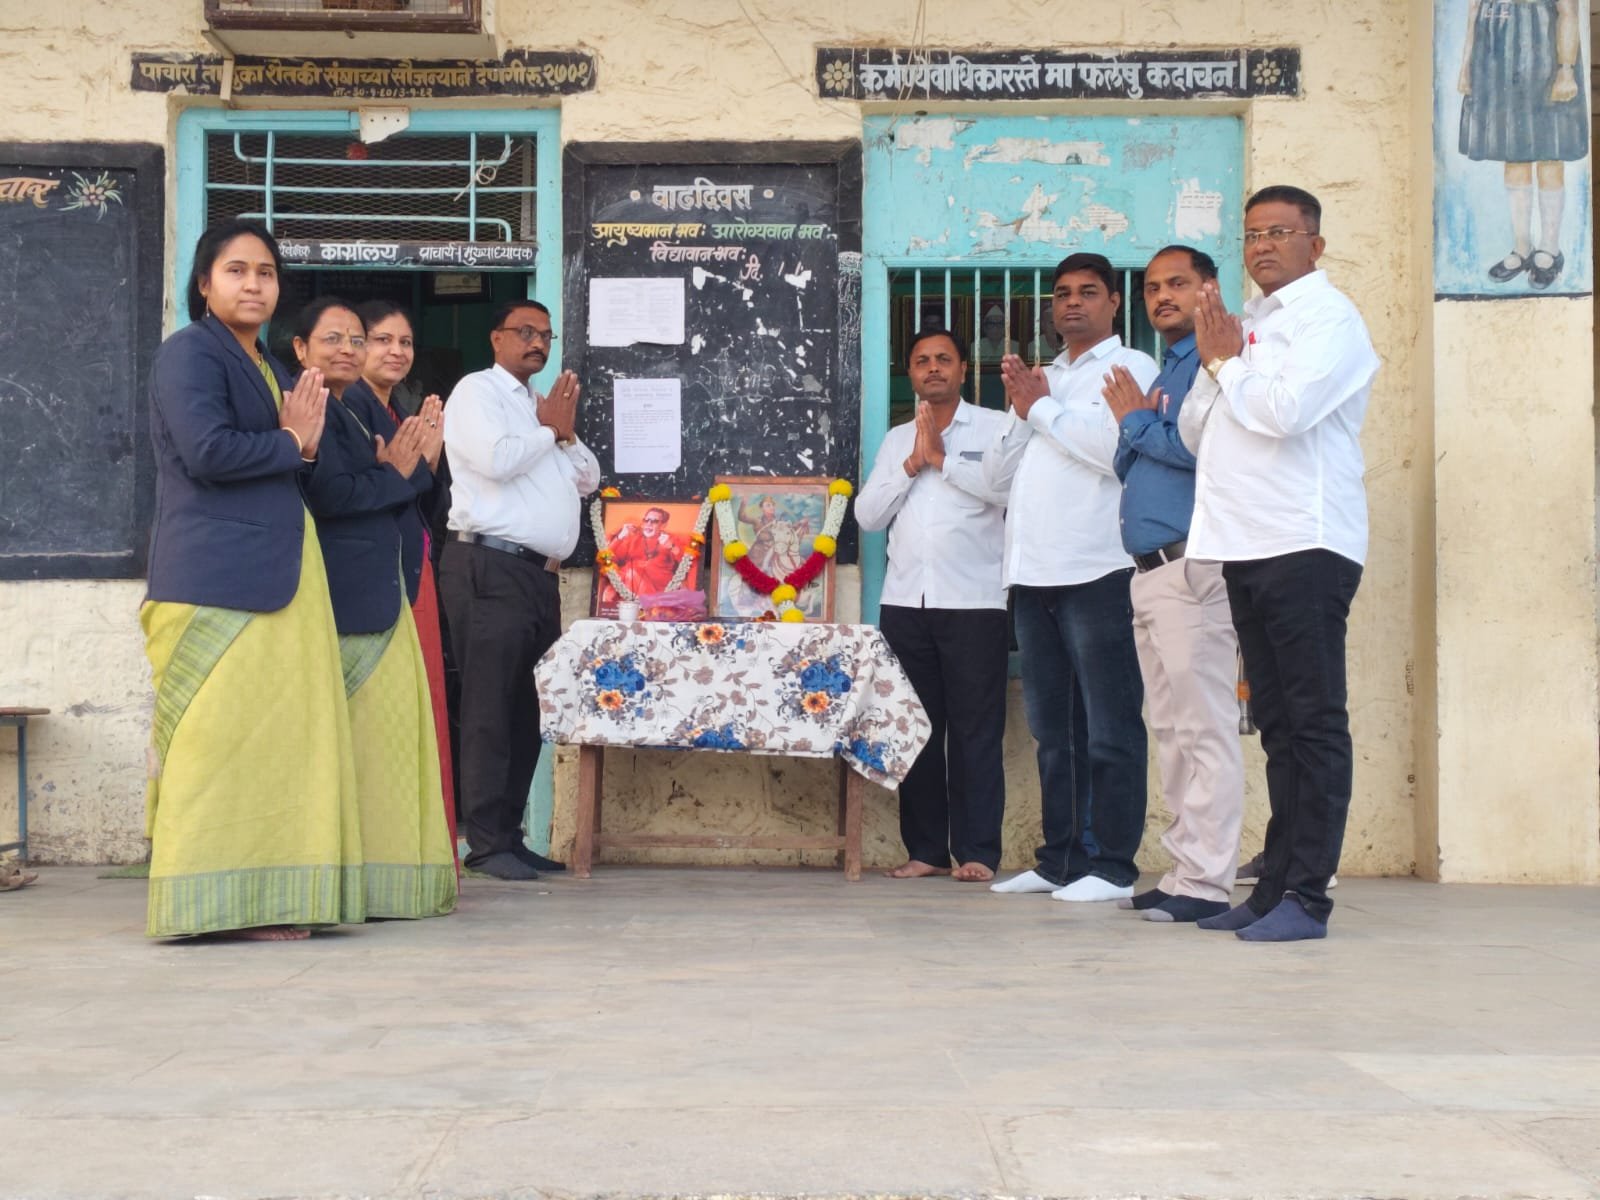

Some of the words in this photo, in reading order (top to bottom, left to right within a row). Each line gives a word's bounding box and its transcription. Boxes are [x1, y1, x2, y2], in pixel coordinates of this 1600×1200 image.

[1044, 62, 1076, 89] मा
[1077, 56, 1144, 99] फलेषु
[651, 177, 754, 211] वाढदिवस
[591, 223, 676, 248] आयुष्यमान
[711, 216, 797, 240] आरोग्यवान
[320, 240, 399, 261] कार्यालय
